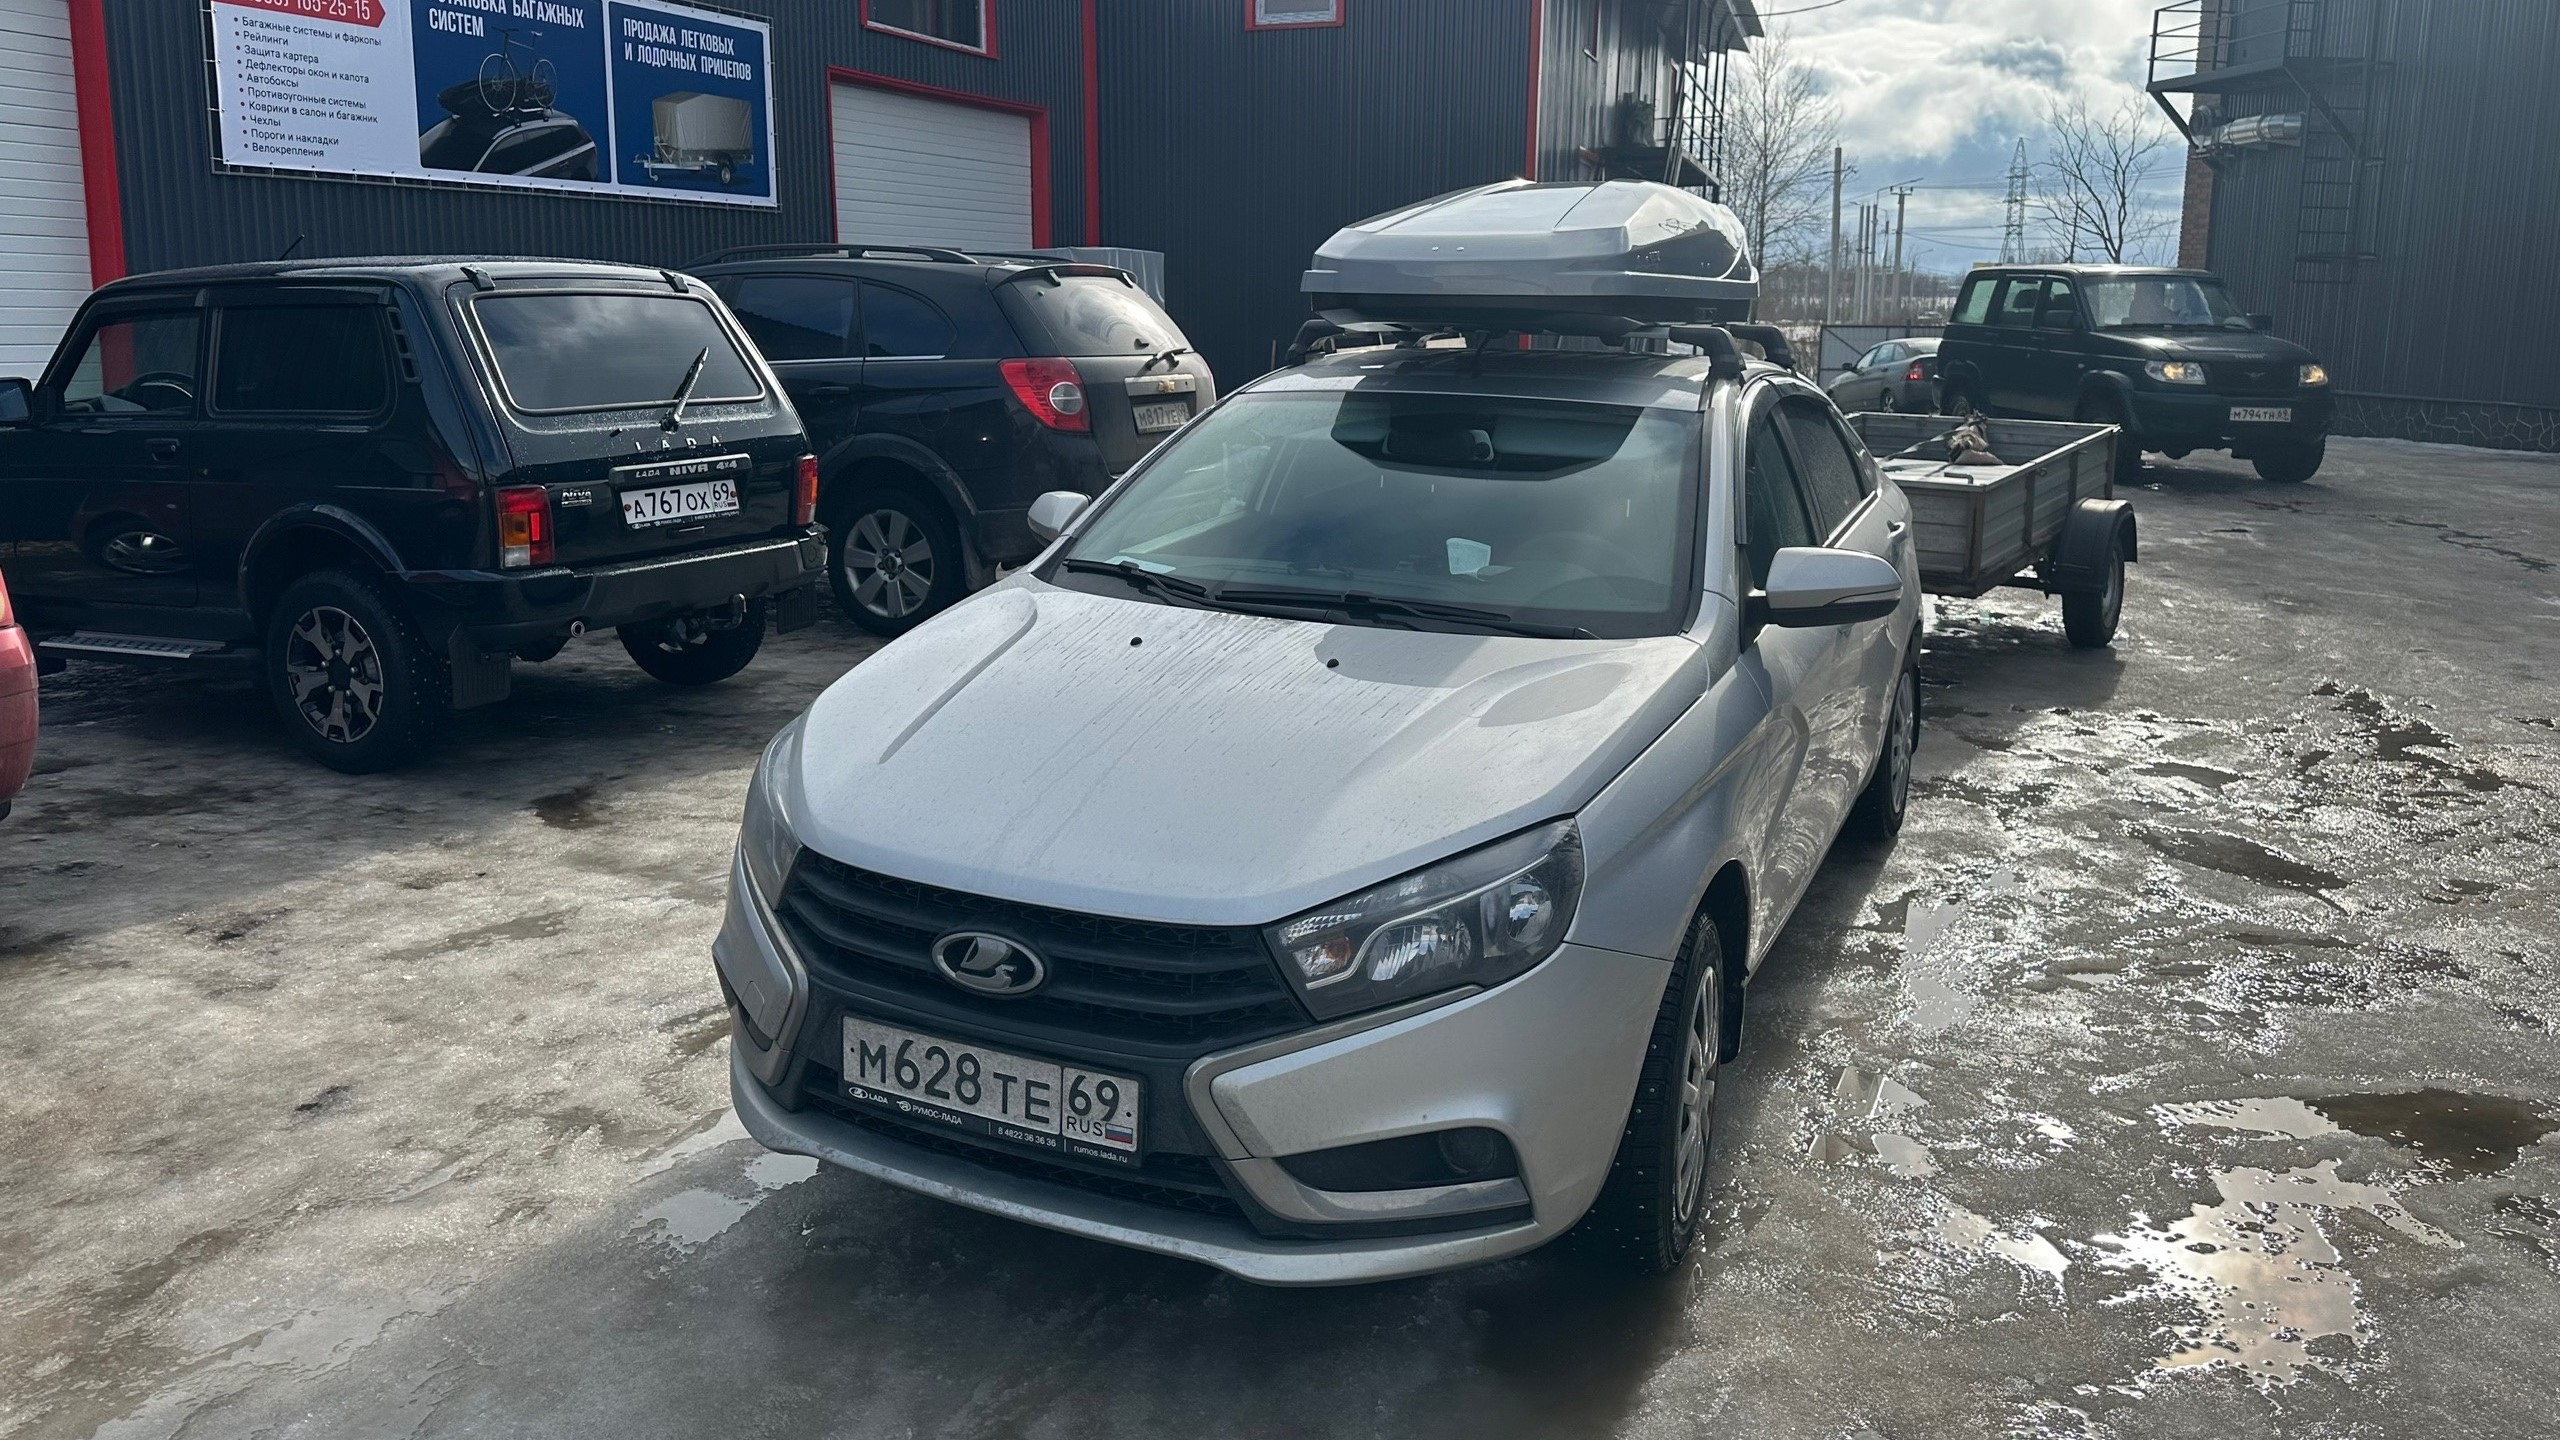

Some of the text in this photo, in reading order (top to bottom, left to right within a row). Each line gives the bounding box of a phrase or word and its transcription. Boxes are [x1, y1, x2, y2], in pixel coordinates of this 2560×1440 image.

[429, 8, 484, 37] СИСТЕМ
[512, 0, 585, 29] БАГАЖНЫХ
[242, 16, 382, 46] Багажные системы и фаркопы
[243, 31, 289, 46] Рейлинги
[623, 17, 735, 56] ПРОДАЖА ЛЕГКОВЫХ
[244, 45, 319, 64] Защита картера
[624, 42, 752, 81] И ЛОДОЧНЫХ ПРИЦЕПОВ
[245, 59, 370, 84] Дефлекторы окон и капота
[246, 73, 299, 88] Автобоксы
[248, 87, 367, 109] Противоугонные системы
[249, 101, 378, 124] Коврики в салон и багажник
[250, 114, 281, 127] Чехлы
[251, 128, 339, 146] Пороги и накладки
[252, 143, 325, 157] Велокрепления
[2233, 408, 2275, 420] М794ТН
[635, 469, 661, 478] LADA
[669, 463, 709, 476] NIVA
[634, 482, 730, 519] А767ОХ 69
[858, 1038, 1121, 1124] М628ТЕ 69
[868, 1092, 889, 1104] LADA
[912, 1104, 963, 1125] РУМОС-ЛАДА
[1004, 1128, 1024, 1140] 4822
[1066, 1116, 1104, 1137] RUS
[1073, 1145, 1129, 1164] rumos.lada.ru
